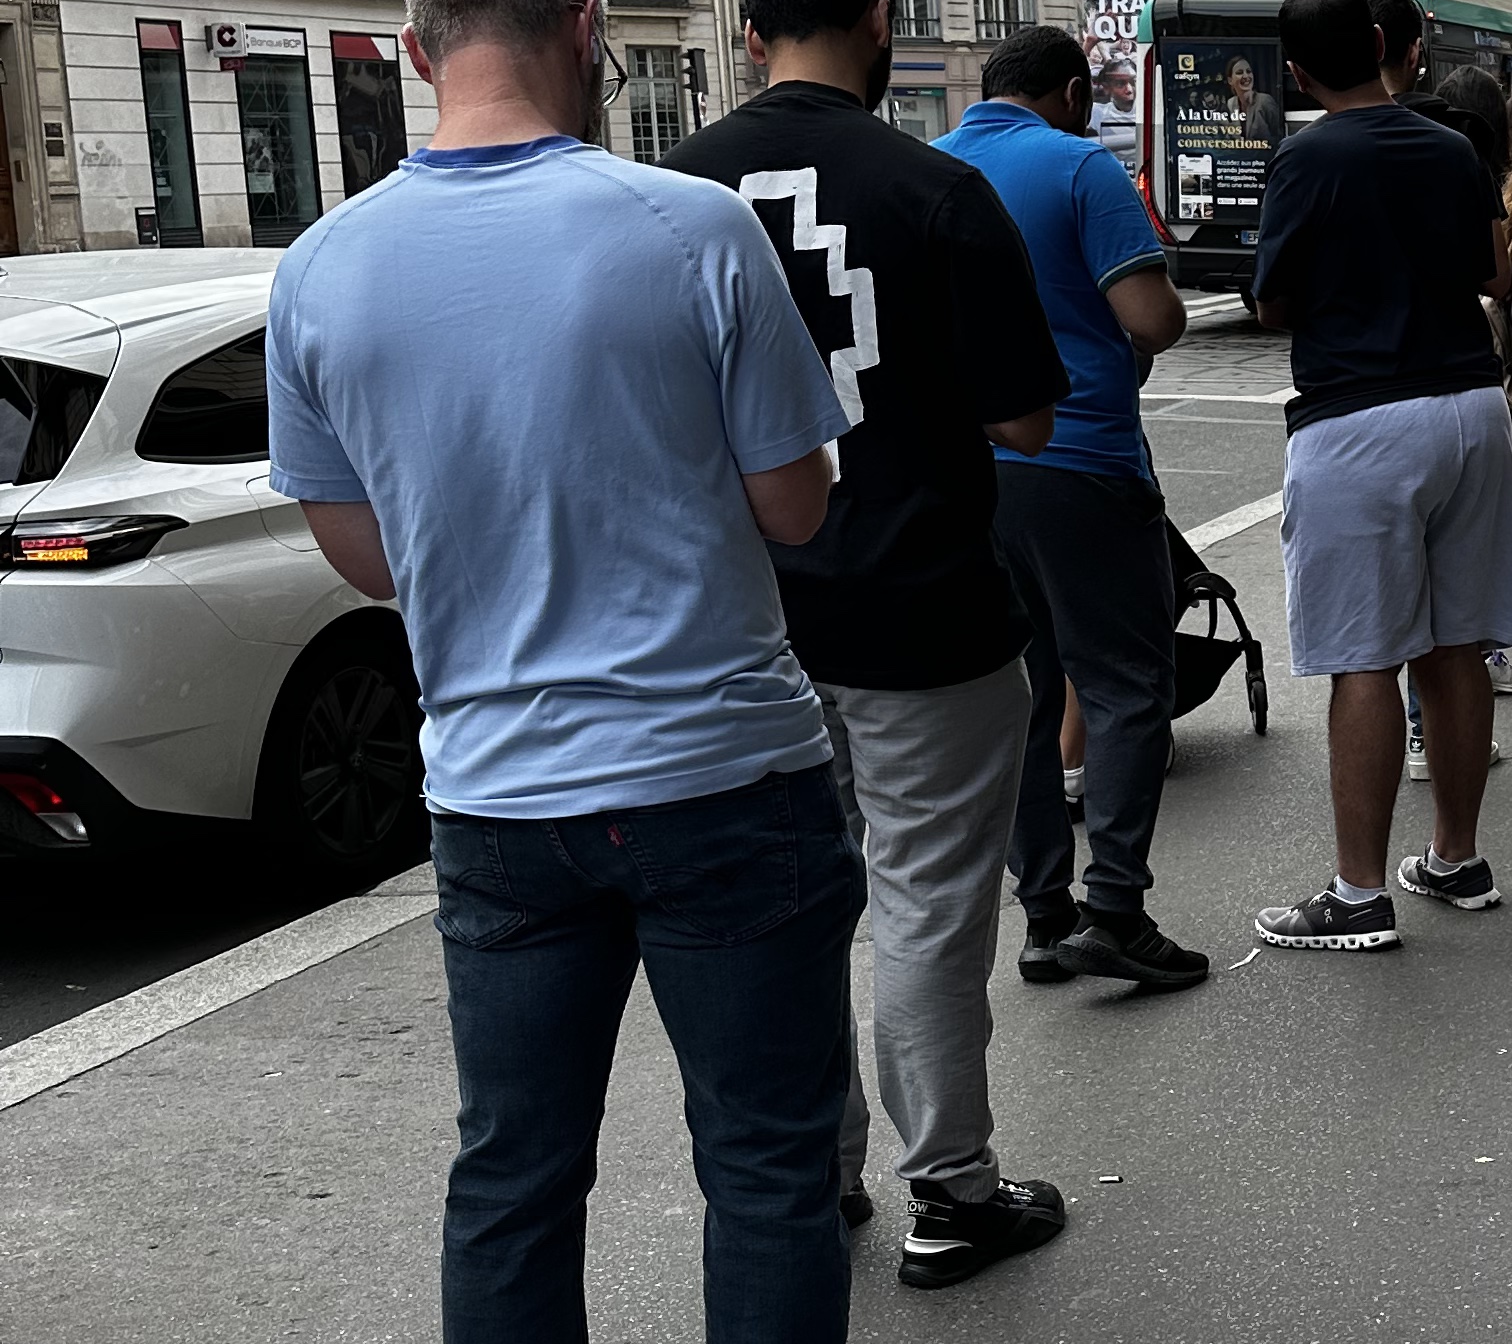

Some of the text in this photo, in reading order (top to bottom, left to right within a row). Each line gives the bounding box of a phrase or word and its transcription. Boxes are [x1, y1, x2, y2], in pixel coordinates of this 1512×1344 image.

[283, 38, 302, 49] BCP
[1176, 105, 1247, 121] À la Une de
[1177, 123, 1243, 135] toutes vos
[1177, 137, 1272, 150] conversations.
